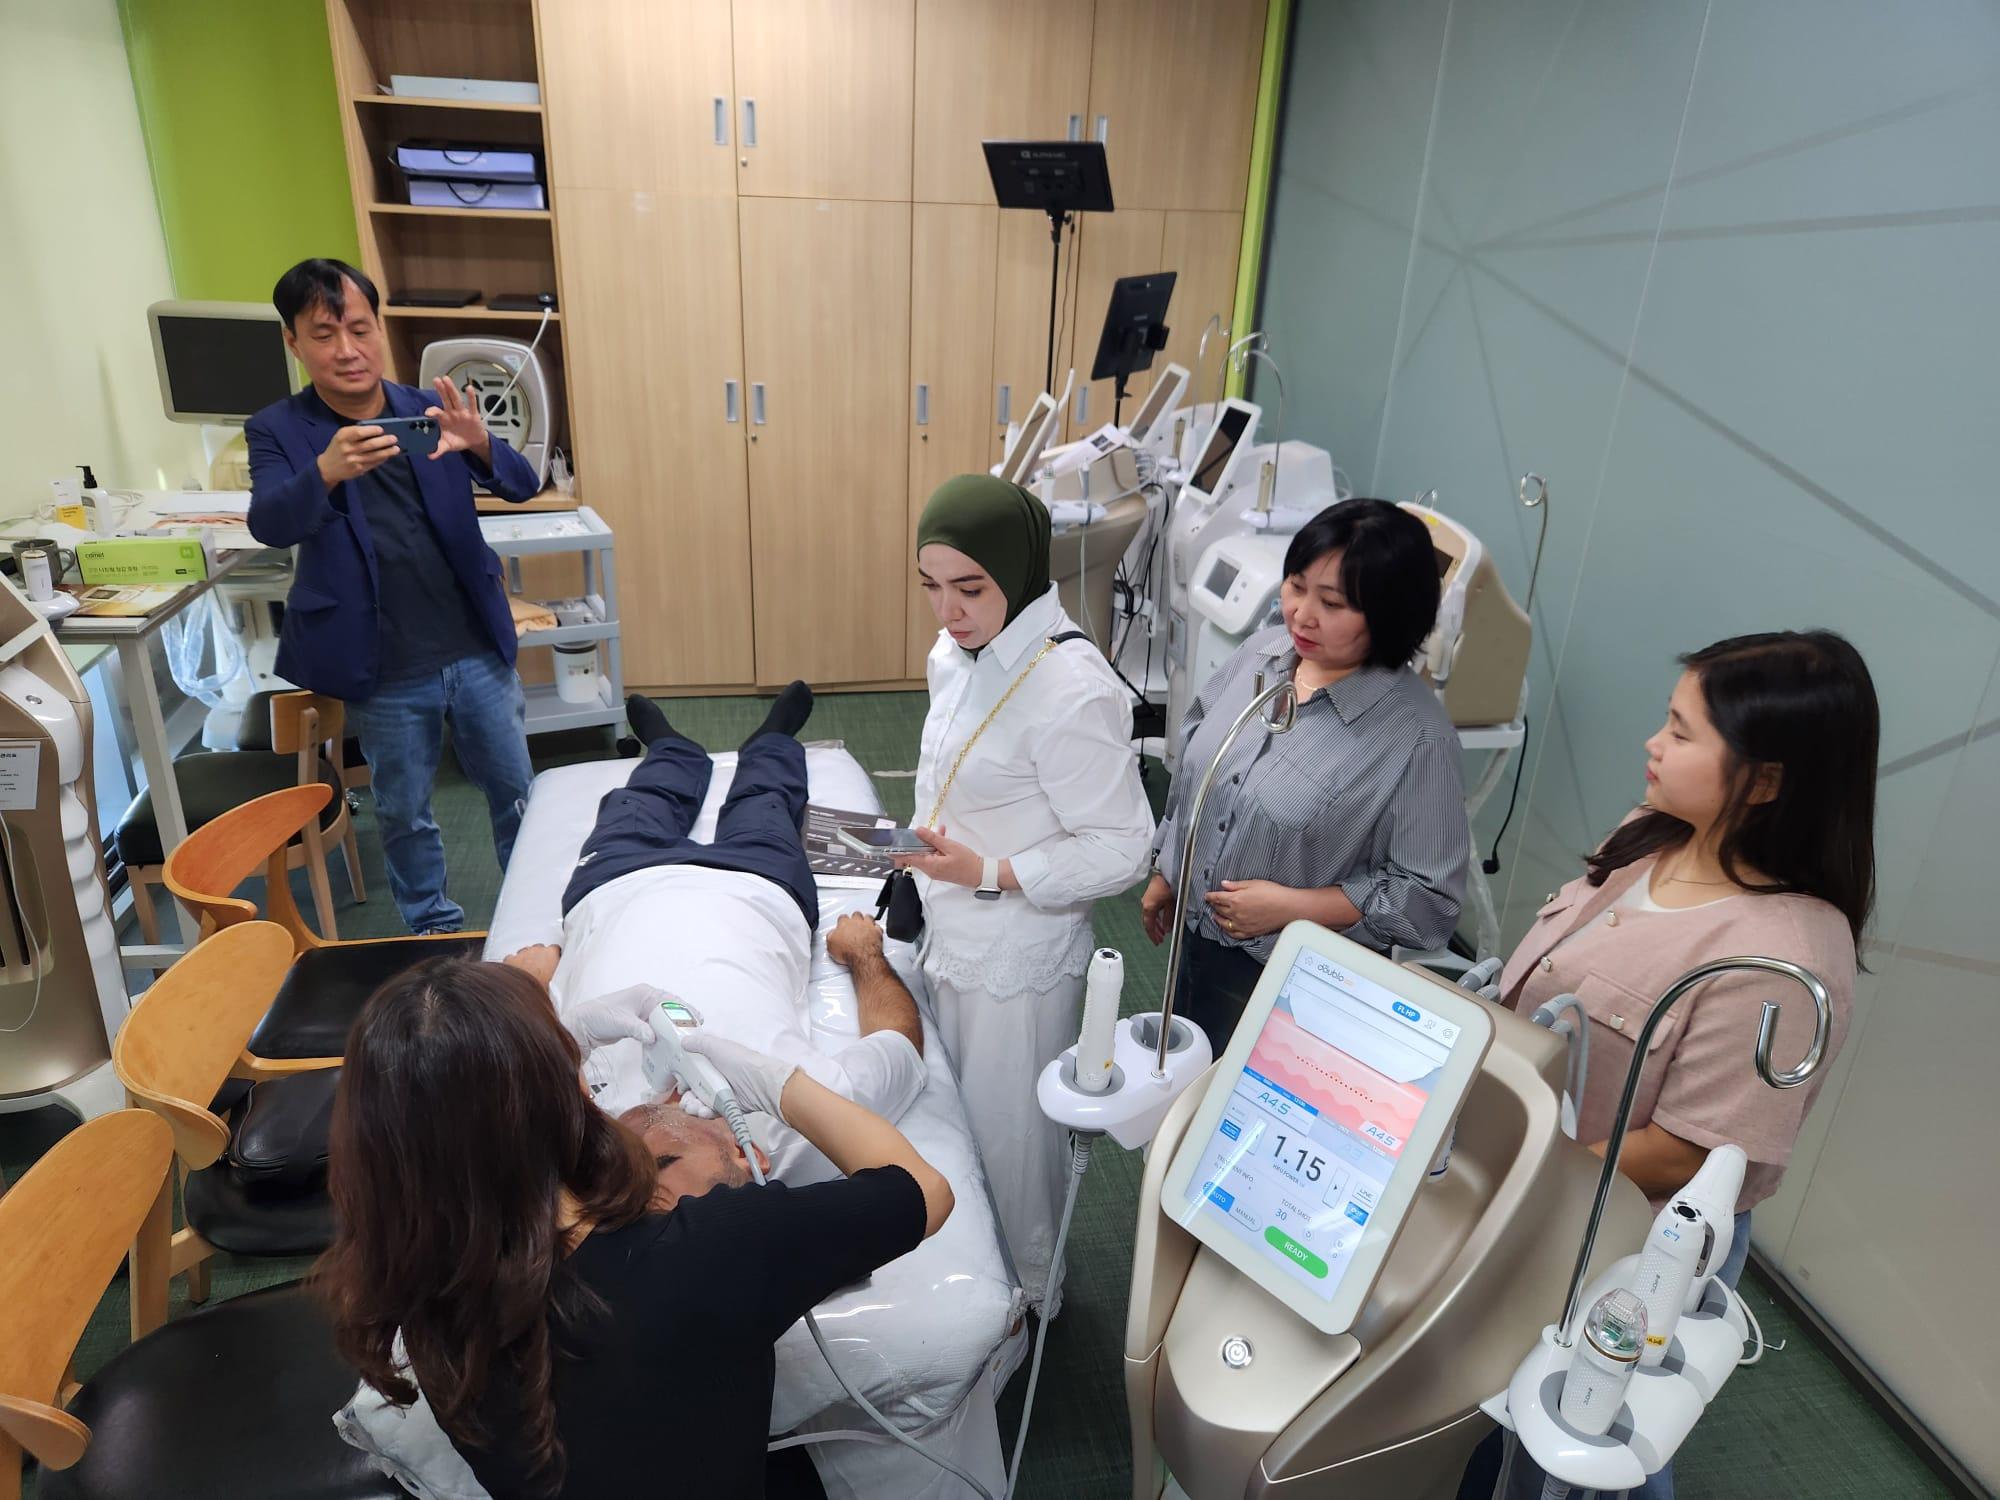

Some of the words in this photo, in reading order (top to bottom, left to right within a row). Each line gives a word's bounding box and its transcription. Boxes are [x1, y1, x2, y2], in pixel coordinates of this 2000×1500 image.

[1274, 1135, 1326, 1182] 1.15
[1275, 1208, 1288, 1221] 30
[1284, 1241, 1309, 1261] READY
